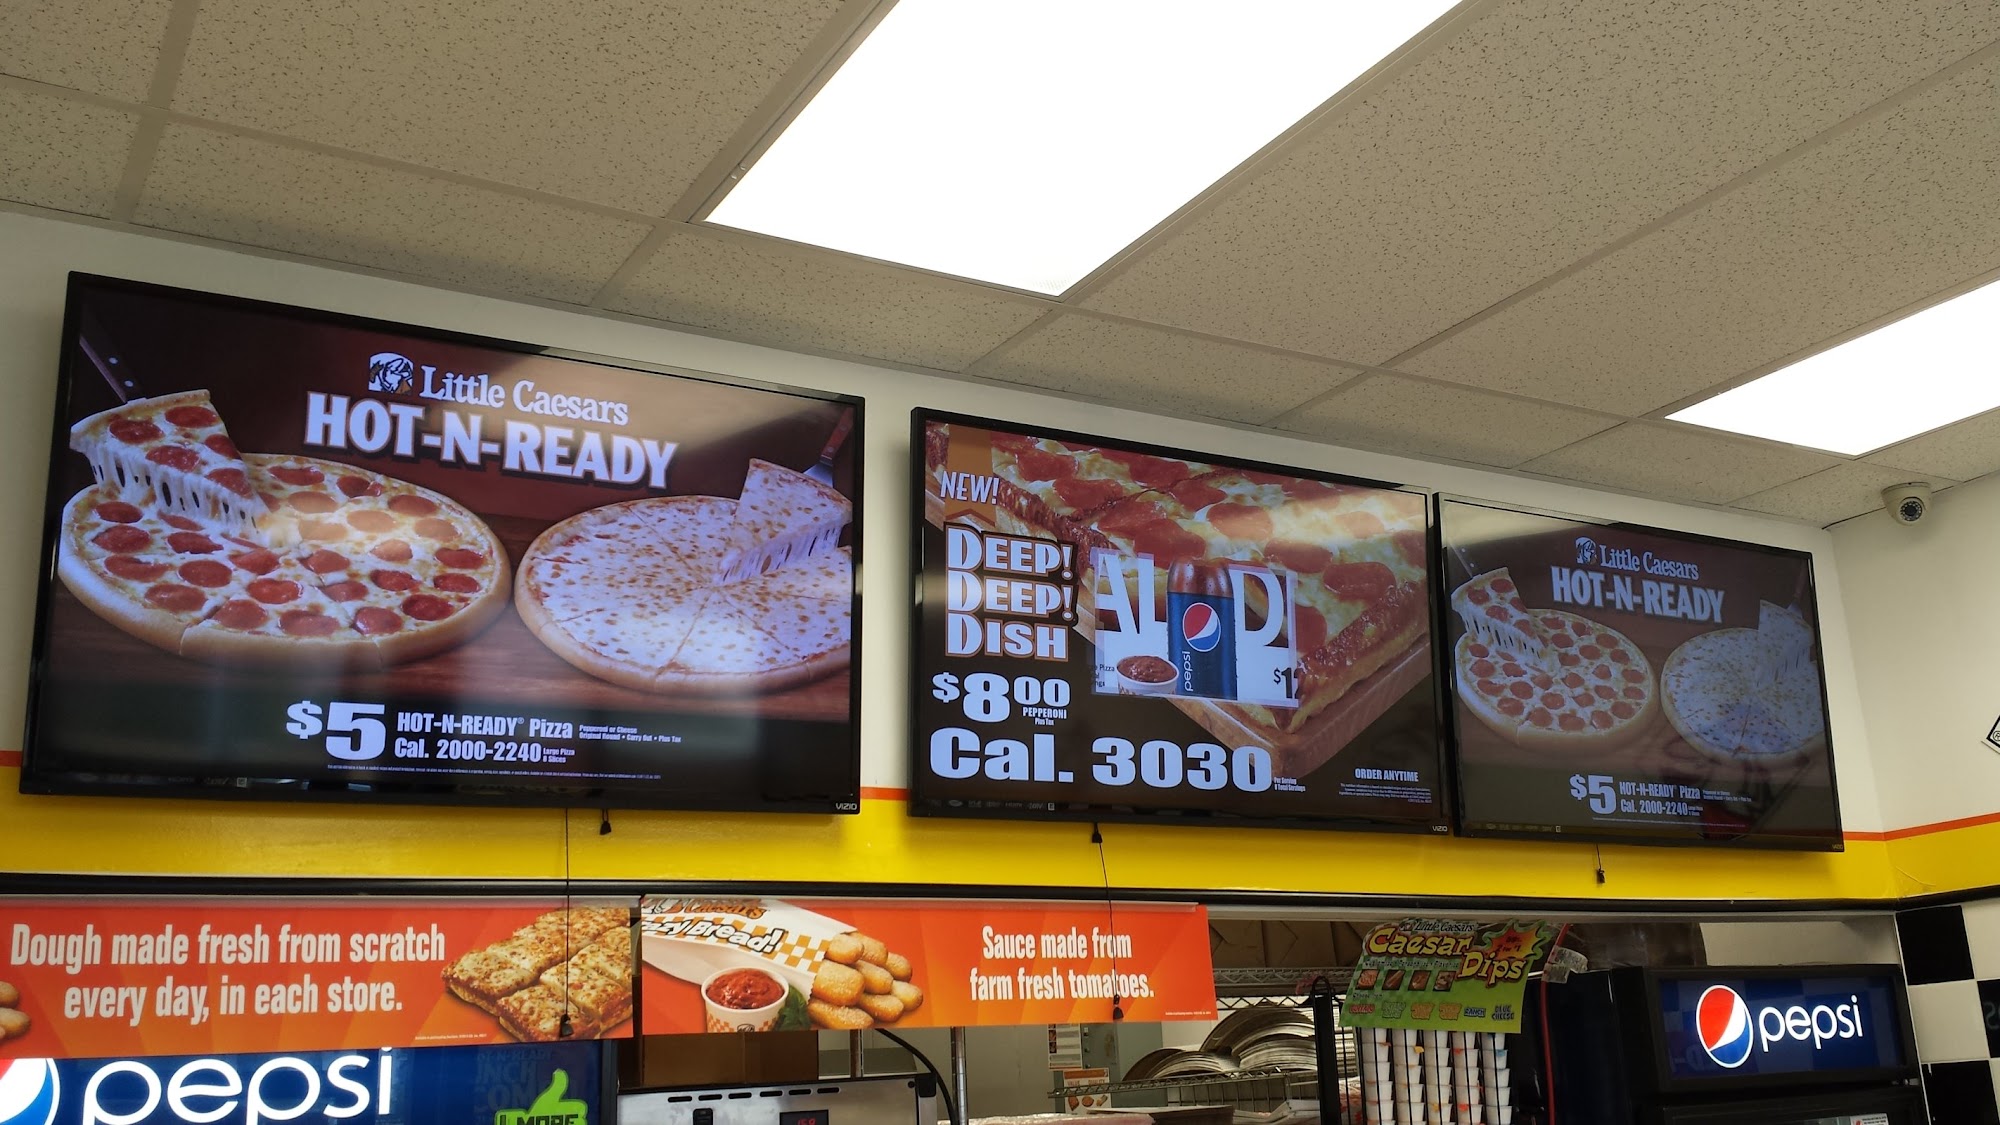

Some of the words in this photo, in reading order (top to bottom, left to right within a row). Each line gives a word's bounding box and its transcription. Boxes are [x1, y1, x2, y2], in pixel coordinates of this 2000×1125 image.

[420, 365, 505, 408] Little
[513, 379, 629, 426] Caesars
[304, 390, 679, 489] HOT-N-READY
[940, 470, 1000, 504] NEW!
[947, 526, 1073, 579] DEEP!
[1599, 544, 1641, 572] Little
[1643, 551, 1699, 581] Caesars
[947, 569, 1073, 620] DEEP!
[1551, 565, 1725, 623] HOT-N-READY
[947, 612, 1067, 660] DISH
[1182, 650, 1194, 692] pepsi
[285, 700, 387, 761] $5
[529, 718, 573, 739] Pizza
[1022, 706, 1067, 719] PEPPERONI
[394, 737, 429, 759] Cal.
[436, 739, 542, 763] 2000-2240
[930, 727, 1074, 783] Cal.
[1091, 736, 1273, 793] 3030
[1354, 768, 1382, 780] ORDER
[1383, 769, 1419, 782] ANYTIME
[1679, 785, 1700, 799] Pizza
[1569, 774, 1617, 815] $5
[1620, 799, 1637, 813] Cal.
[1640, 800, 1688, 816] 2000-2240
[686, 920, 786, 954] Bread!
[981, 925, 1036, 960] Sauce
[1041, 926, 1088, 959] made
[1092, 927, 1132, 959] from
[1369, 927, 1474, 956] Caesar
[1440, 921, 1474, 932] Caesars
[10, 922, 102, 975] Dough
[111, 924, 189, 965] made
[197, 924, 269, 964] fresh
[278, 924, 341, 963] from
[349, 923, 446, 963] scratch
[970, 967, 1013, 1001] farm
[1017, 967, 1065, 1000] fresh
[1068, 968, 1155, 999] tomatoes.
[1458, 951, 1527, 985] Dips
[64, 980, 147, 1027] every
[155, 975, 209, 1025] day,
[219, 974, 245, 1015] in
[255, 974, 318, 1014] each
[327, 978, 403, 1013] store.
[1758, 994, 1864, 1053] pepsi
[83, 1046, 393, 1125] pepsi
[517, 1113, 578, 1125] MORE
